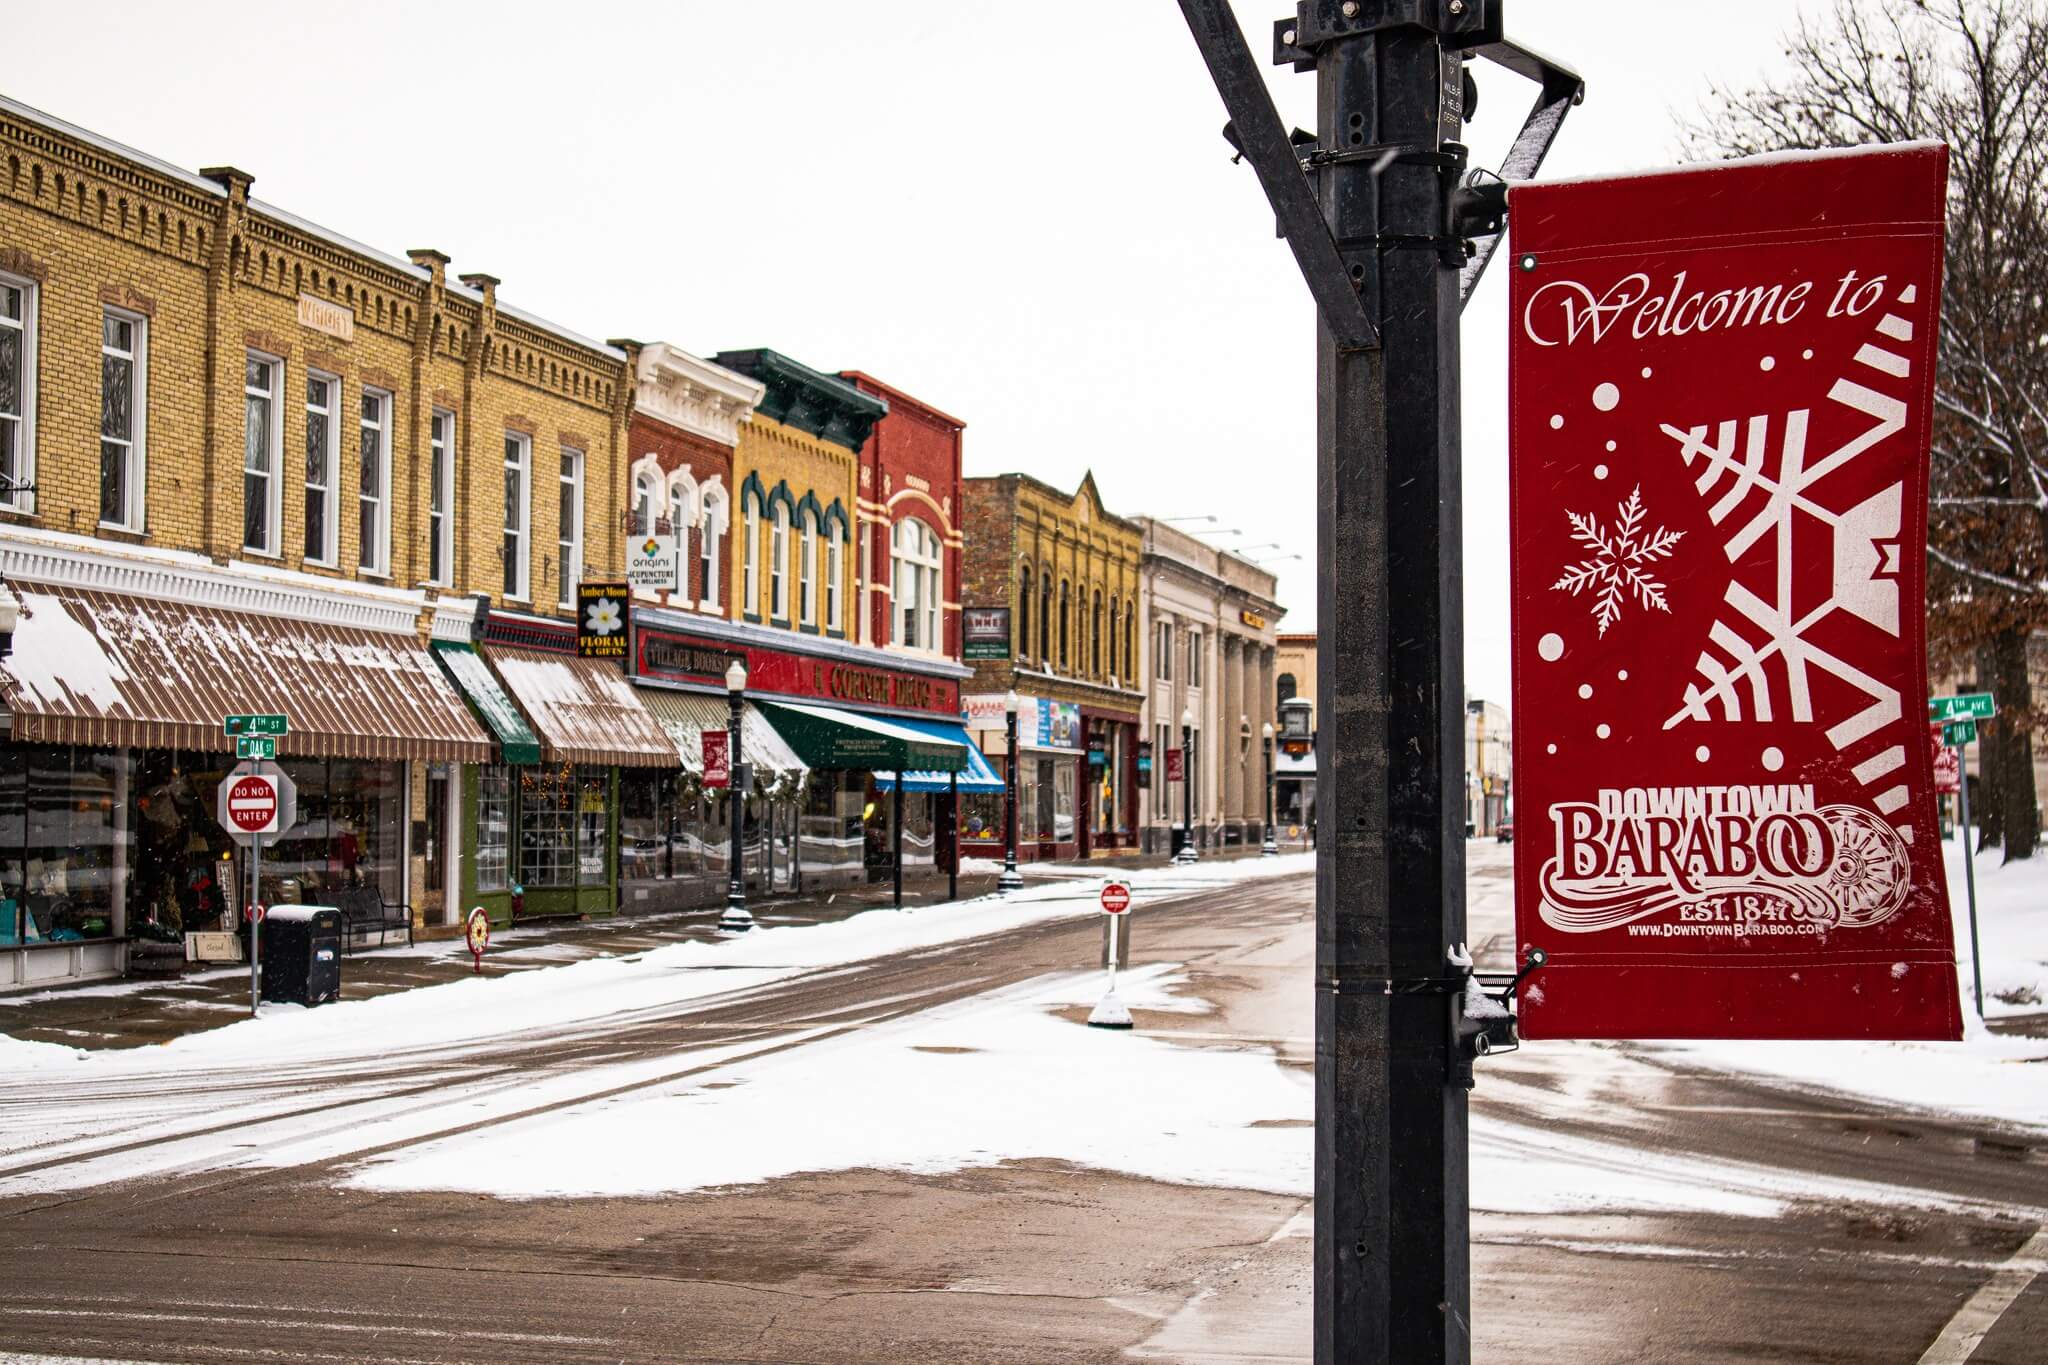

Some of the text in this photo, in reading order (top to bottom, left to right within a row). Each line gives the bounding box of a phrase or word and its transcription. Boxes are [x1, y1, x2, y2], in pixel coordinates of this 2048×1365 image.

[1523, 270, 1888, 347] Welcome to
[628, 570, 675, 580] ACUPUNCTURE
[580, 586, 628, 598] Amber Moon
[579, 635, 628, 648] FLORAL
[584, 647, 593, 656] &
[651, 643, 690, 668] VILLAGE
[832, 666, 889, 704] CORNER
[895, 676, 931, 707] DRUG
[1946, 699, 1987, 719] 4TH AVE
[249, 717, 280, 734] 4TH ST
[249, 739, 265, 757] OAK
[234, 786, 270, 798] DO NOT
[1598, 784, 1815, 820] DOWNTOWN
[236, 811, 269, 822] ENTER
[1553, 804, 1837, 894] BARABOO
[1679, 895, 1788, 922] EST. 1847
